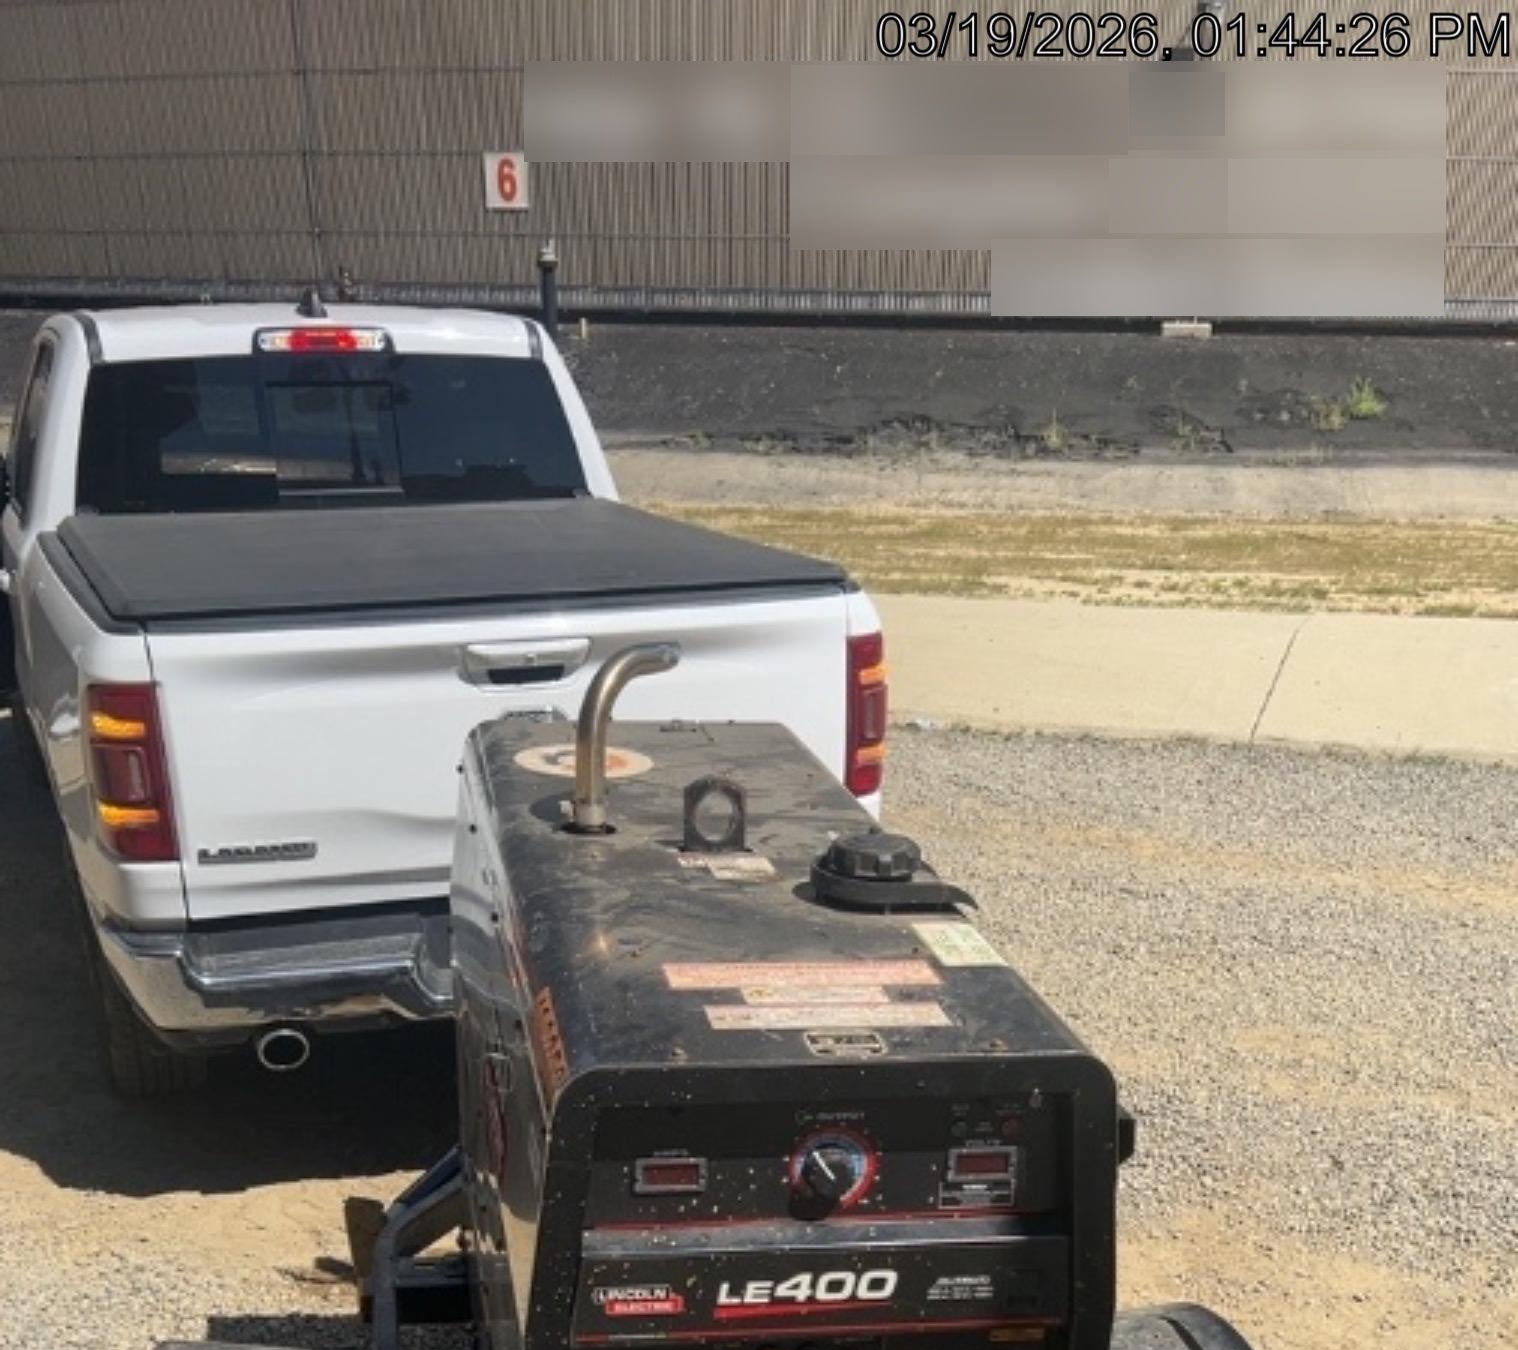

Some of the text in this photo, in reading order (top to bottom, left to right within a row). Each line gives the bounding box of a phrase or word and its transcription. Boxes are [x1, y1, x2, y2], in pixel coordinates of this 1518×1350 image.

[498, 158, 517, 201] 6
[600, 1287, 668, 1301] LINCOLN
[717, 1269, 899, 1306] LE400
